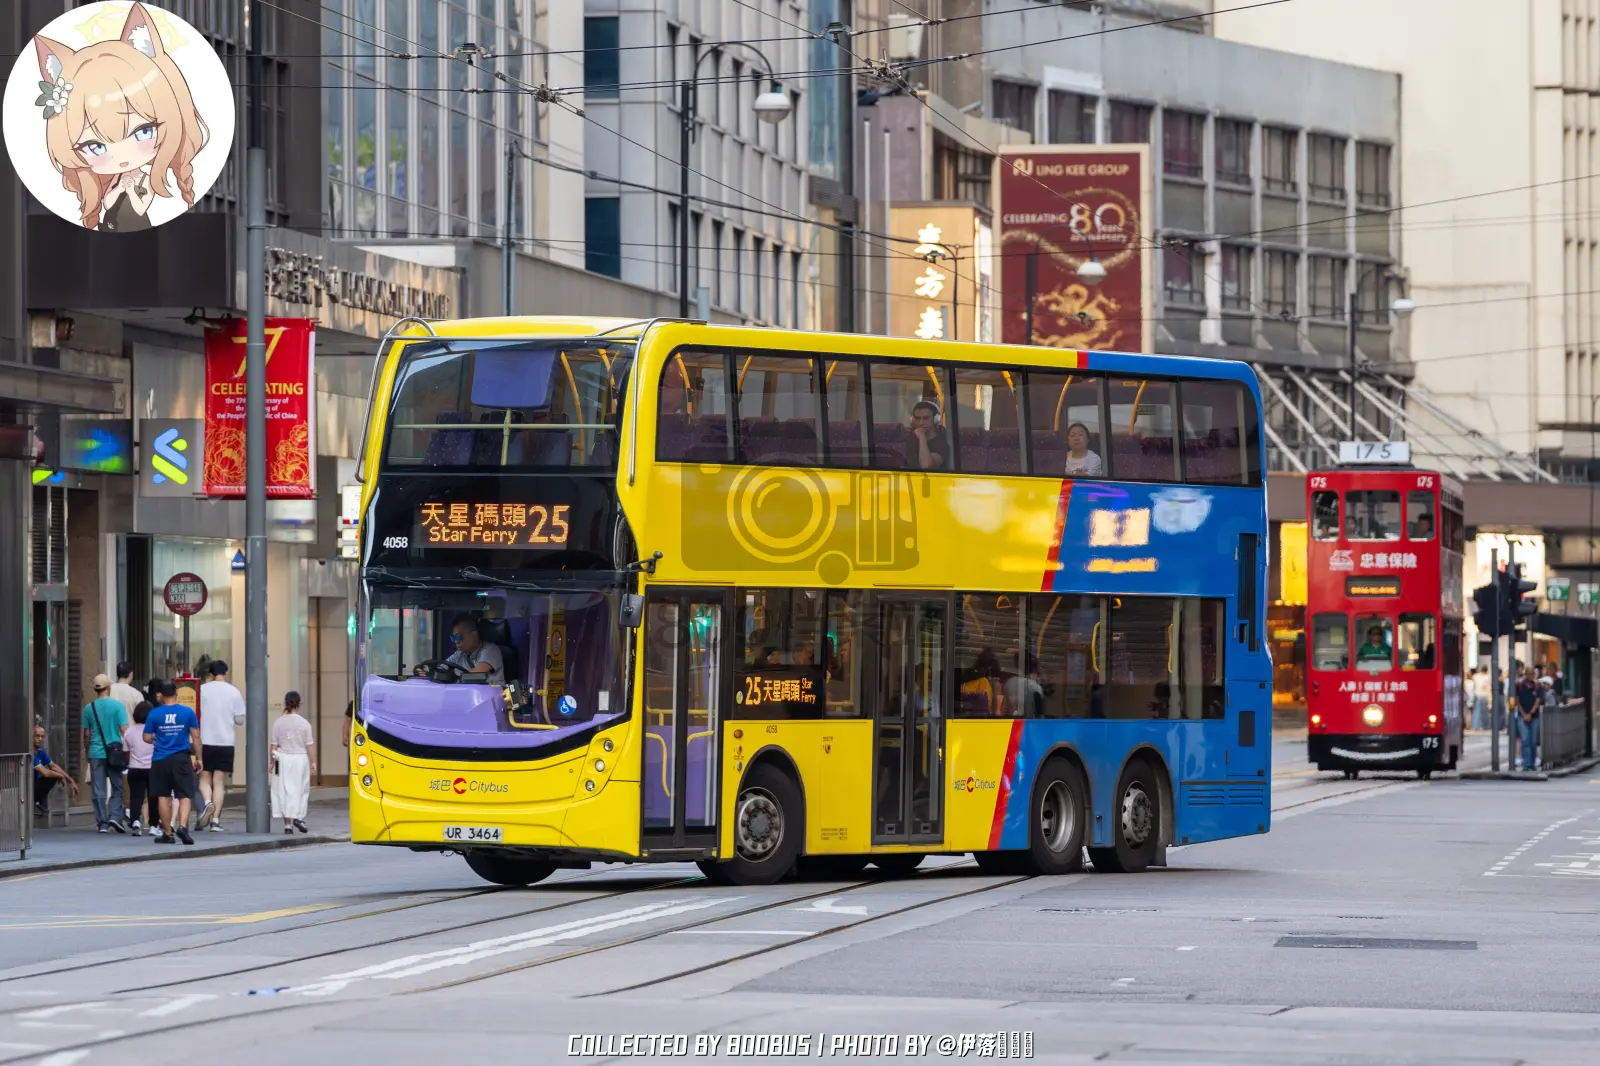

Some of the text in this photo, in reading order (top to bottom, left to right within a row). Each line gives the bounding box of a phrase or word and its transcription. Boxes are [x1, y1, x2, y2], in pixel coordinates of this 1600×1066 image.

[1066, 164, 1086, 176] KEE
[1088, 163, 1130, 177] GROUP
[1003, 202, 1126, 236] CELEBRATING 80
[211, 382, 304, 396] CELEATING
[1354, 443, 1391, 459] 175
[1310, 477, 1327, 489] 175
[1416, 476, 1433, 489] 175
[421, 503, 526, 527] 天星碼頭
[528, 505, 570, 544] 25
[382, 537, 408, 549] 4058
[429, 527, 518, 545] Star Ferry
[1360, 553, 1418, 570] 忠意保險
[801, 677, 814, 690] Star
[745, 678, 761, 706] 25
[763, 679, 801, 703] 天星碼頭
[801, 691, 817, 705] Ferry
[766, 725, 778, 734] 4058
[1422, 738, 1440, 749] 175
[429, 779, 451, 791] 城巴
[469, 780, 509, 793] Citybus
[974, 779, 996, 790] Citybus
[447, 827, 499, 840] UR 3464
